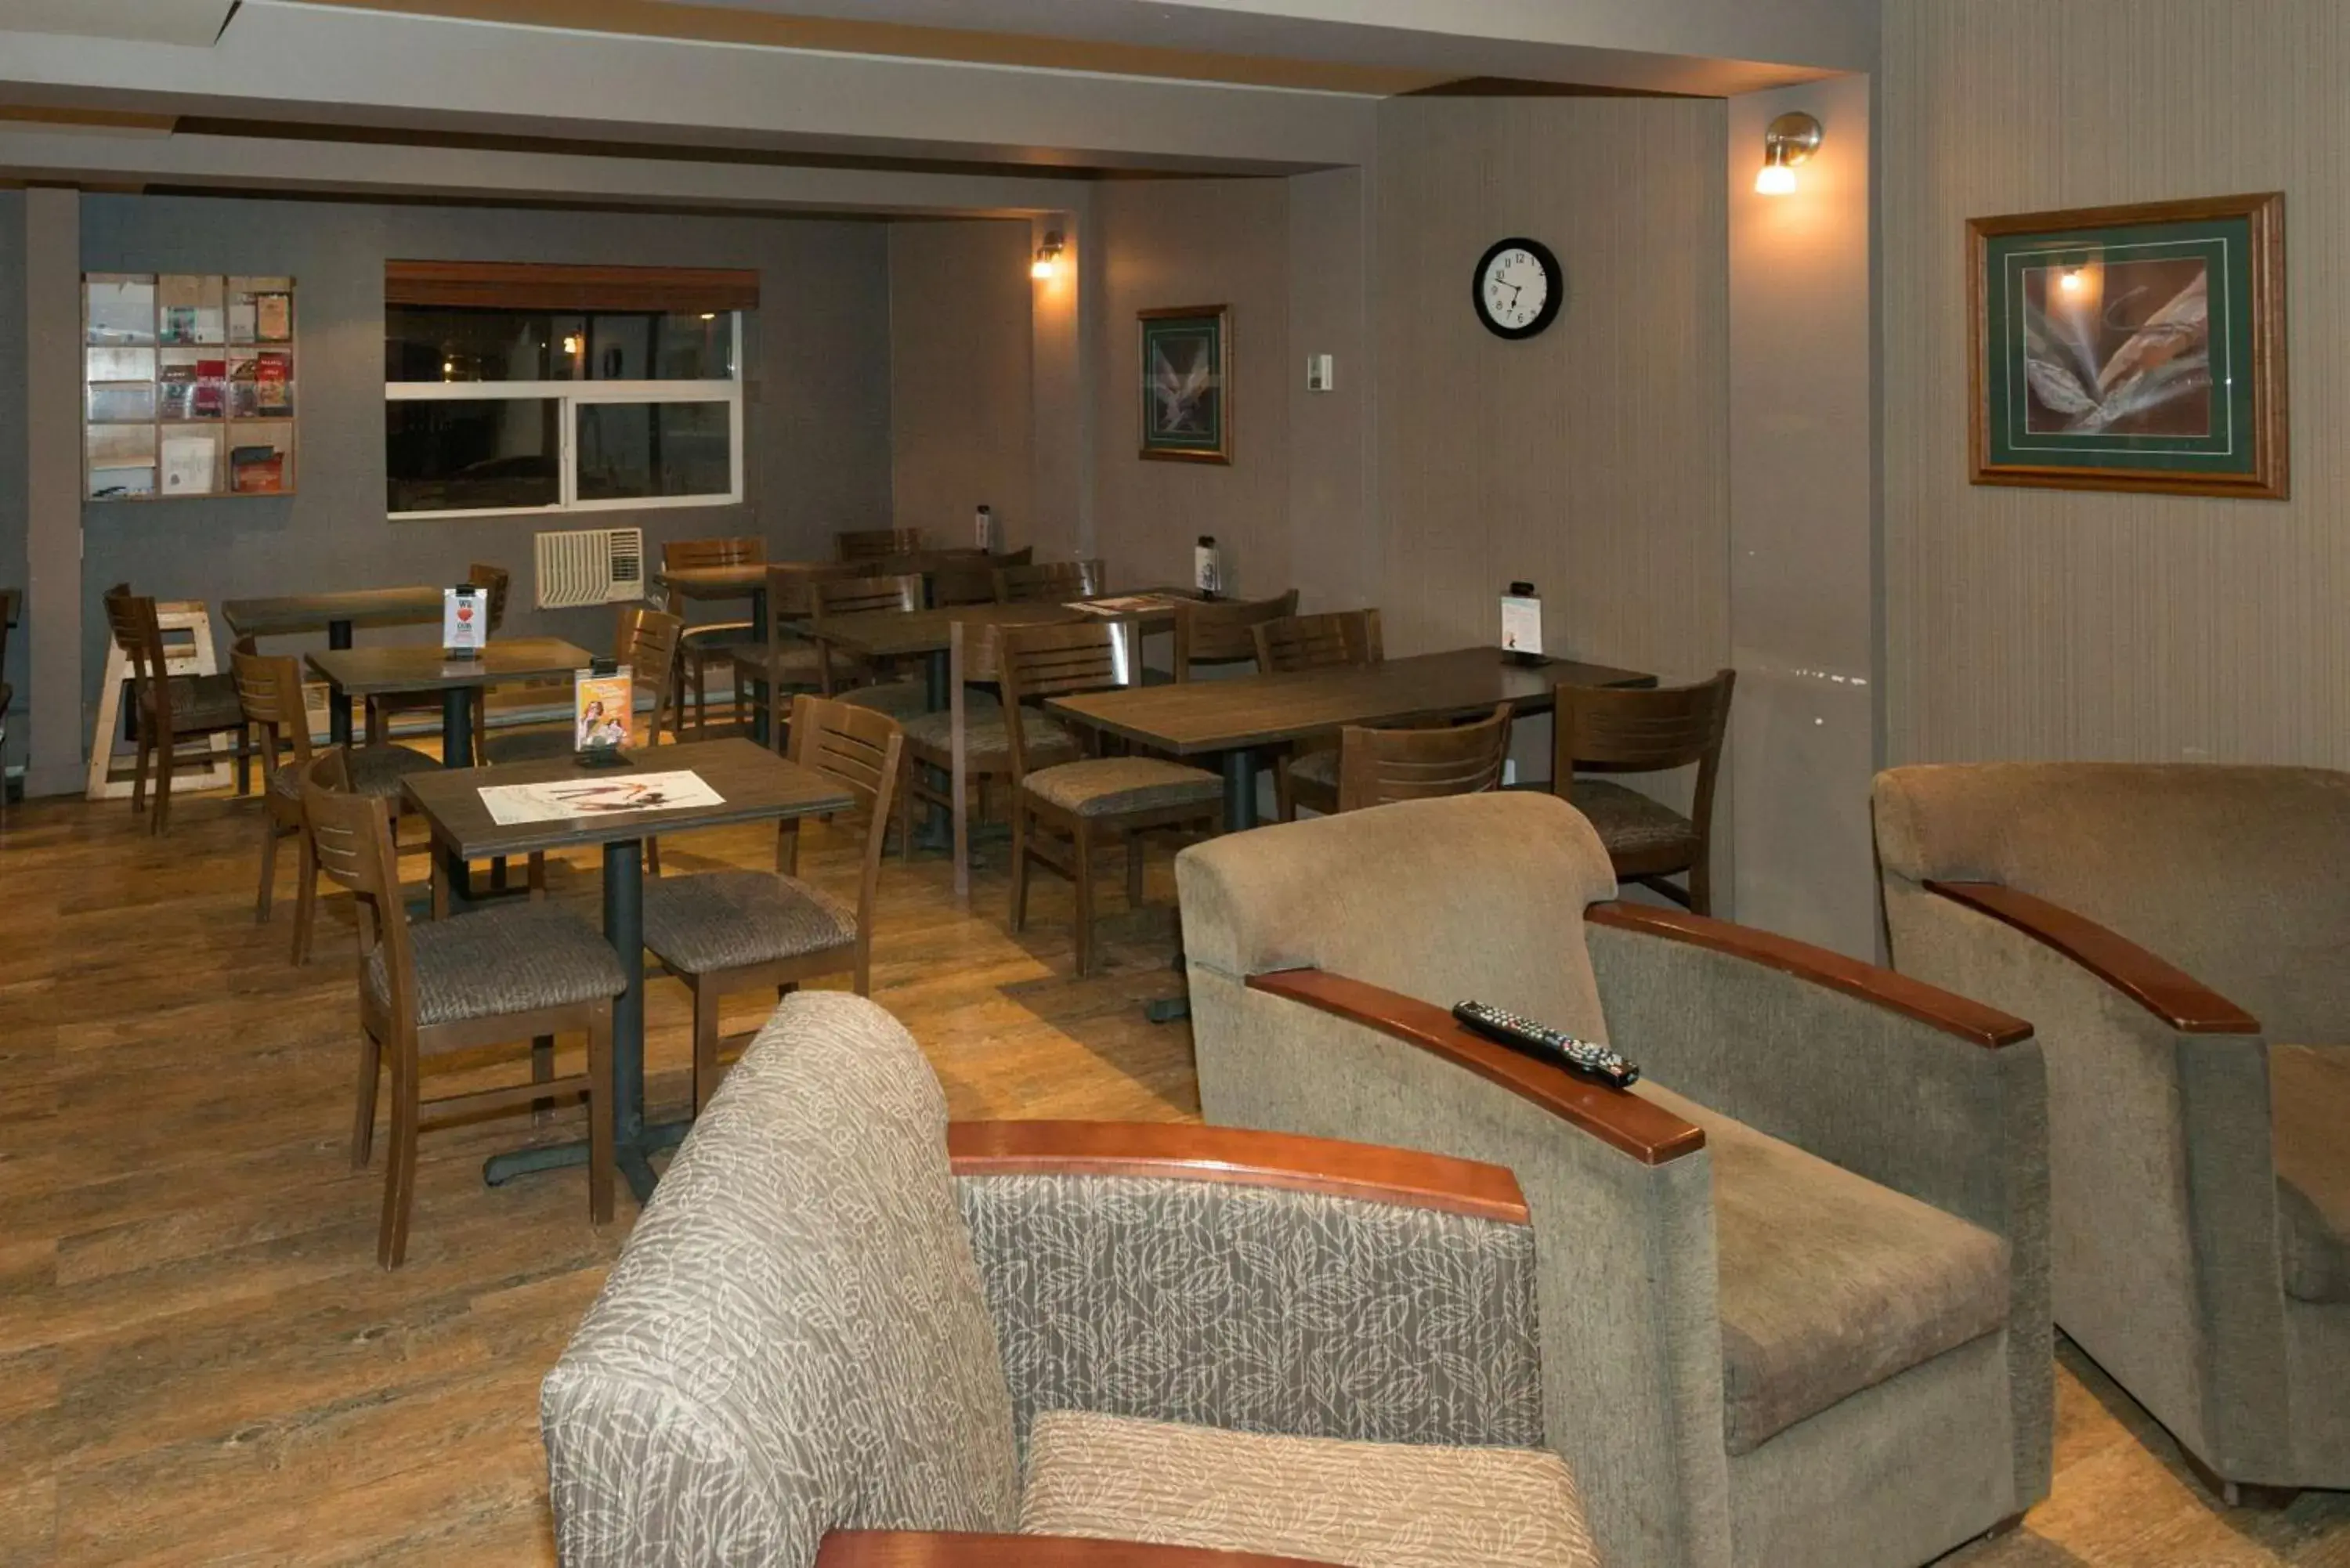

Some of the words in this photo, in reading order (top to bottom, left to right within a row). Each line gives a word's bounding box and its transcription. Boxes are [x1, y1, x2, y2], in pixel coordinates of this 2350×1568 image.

[1505, 258, 1511, 268] 11
[1516, 253, 1524, 264] 12
[1506, 309, 1513, 320] 7
